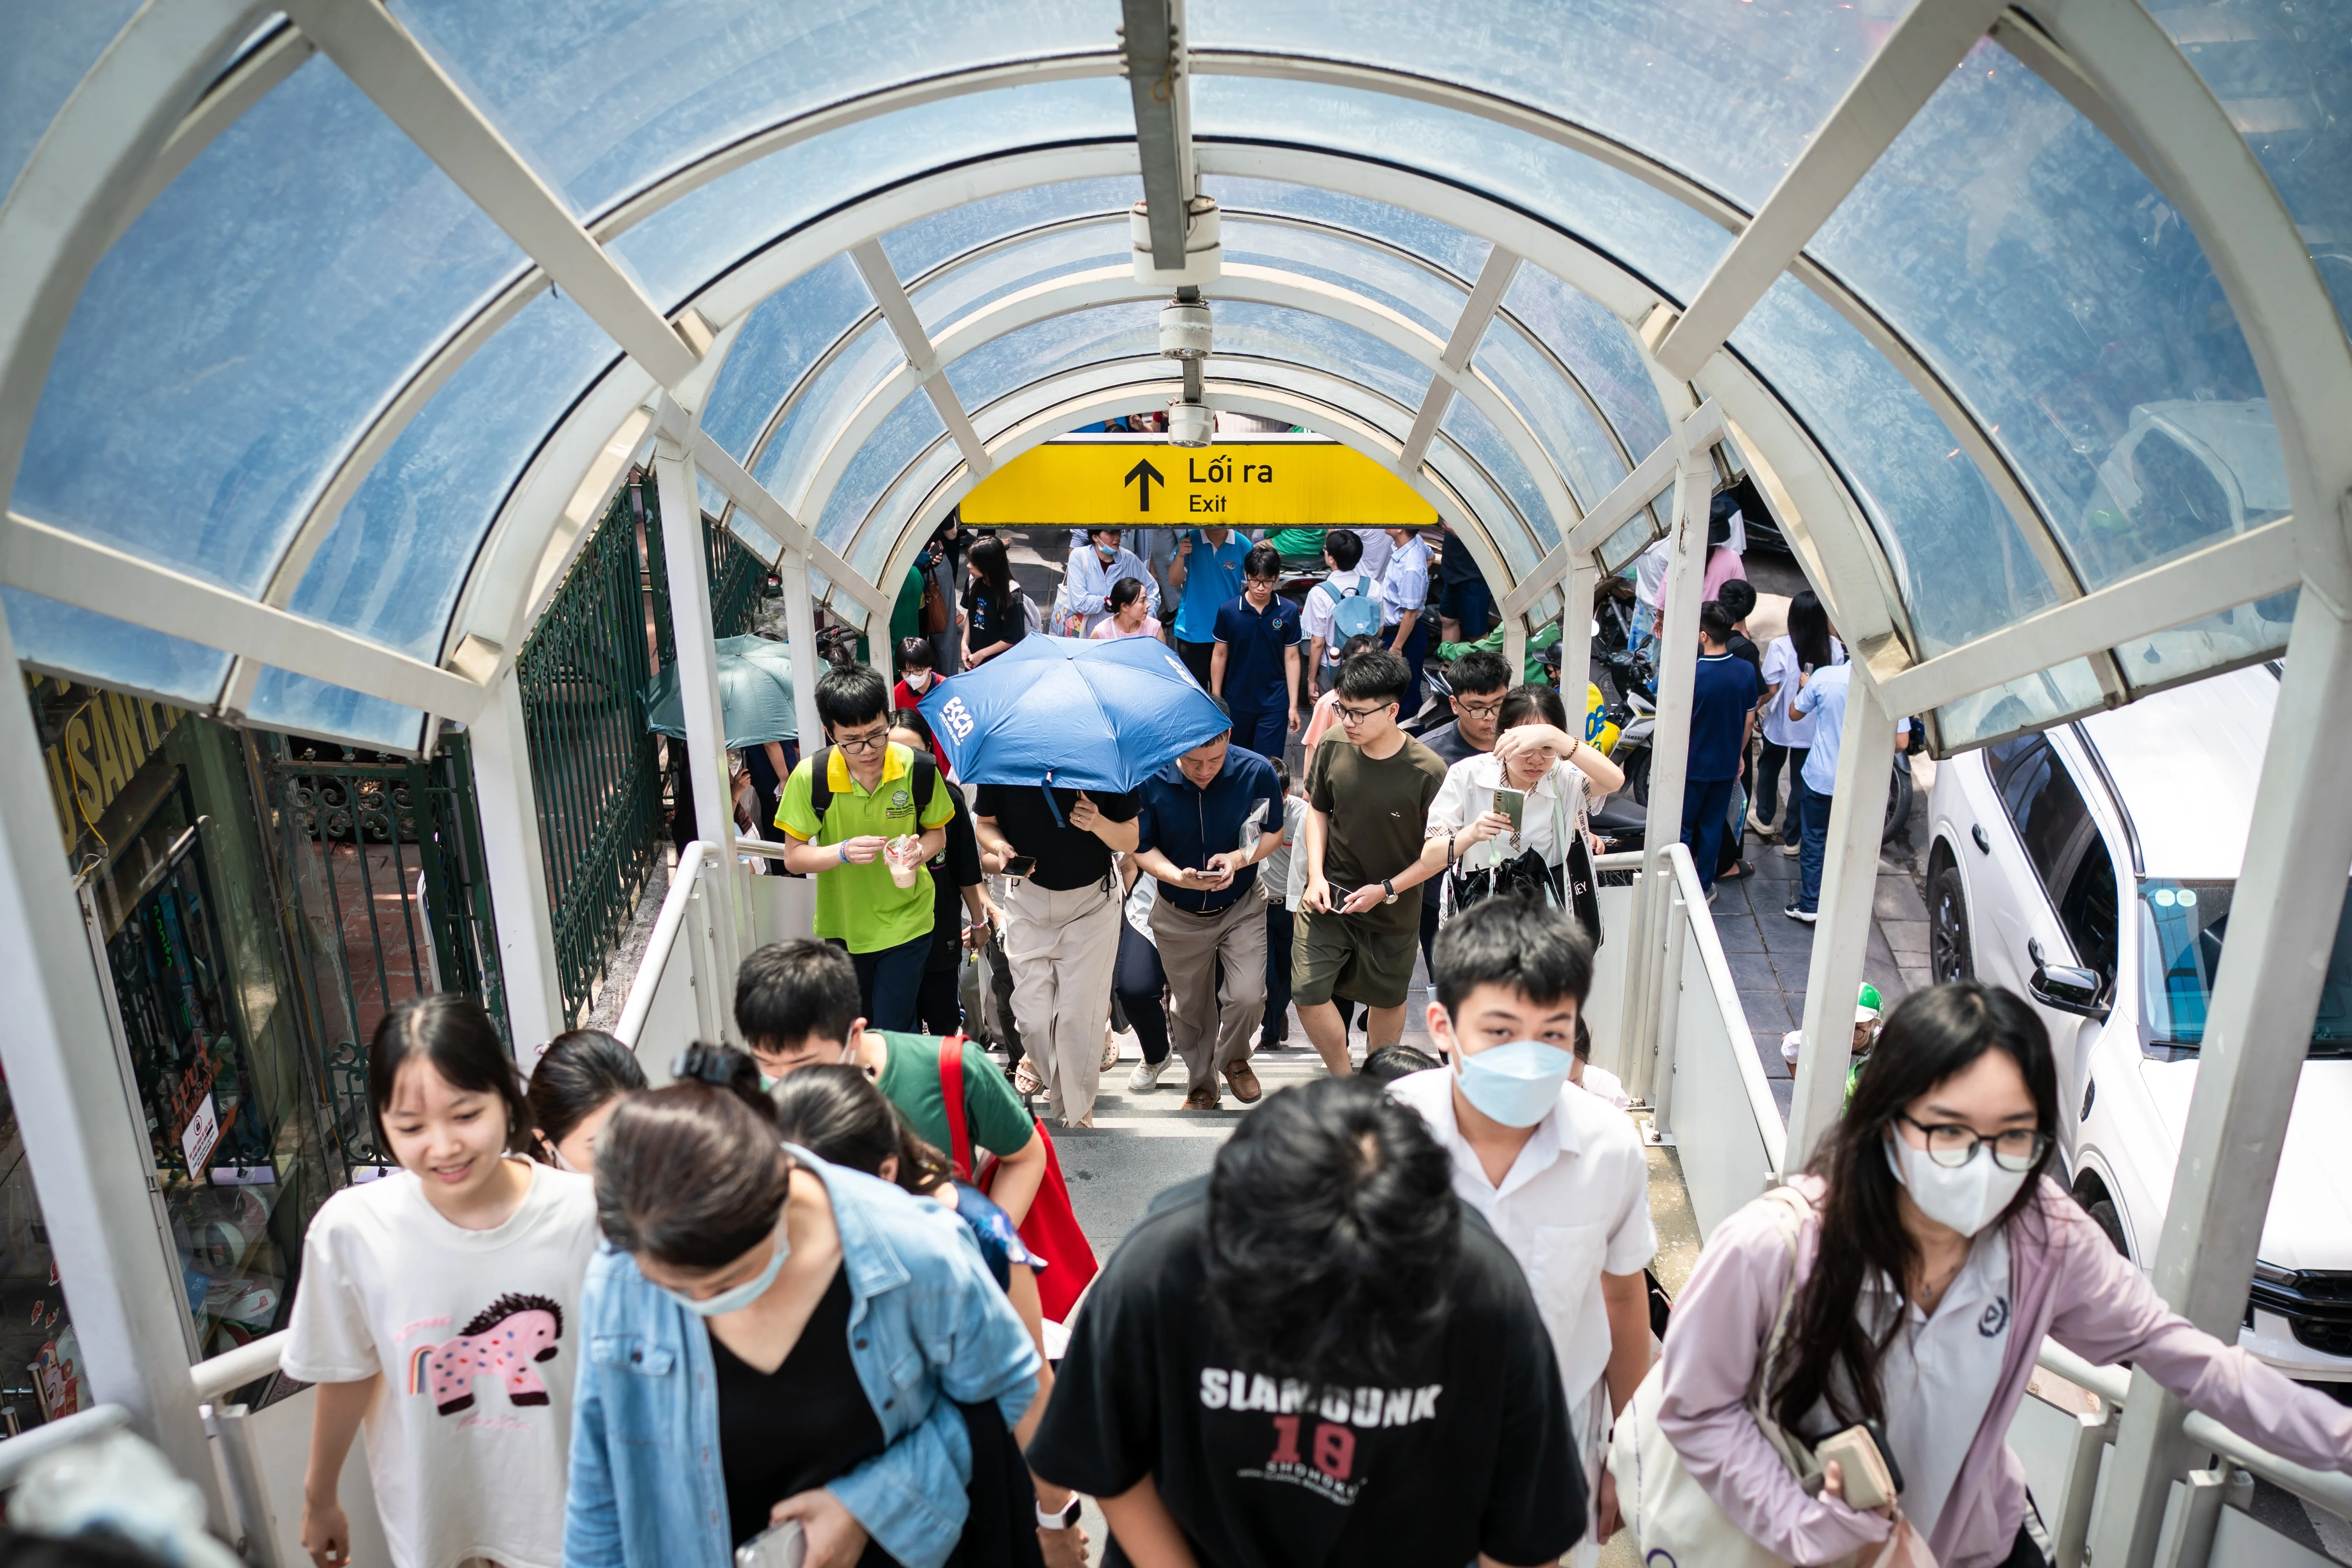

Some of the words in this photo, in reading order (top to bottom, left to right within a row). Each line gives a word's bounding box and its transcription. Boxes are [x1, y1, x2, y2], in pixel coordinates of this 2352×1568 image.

[1190, 455, 1231, 482] Lối
[1244, 465, 1272, 482] ra
[1190, 495, 1226, 512] Exit
